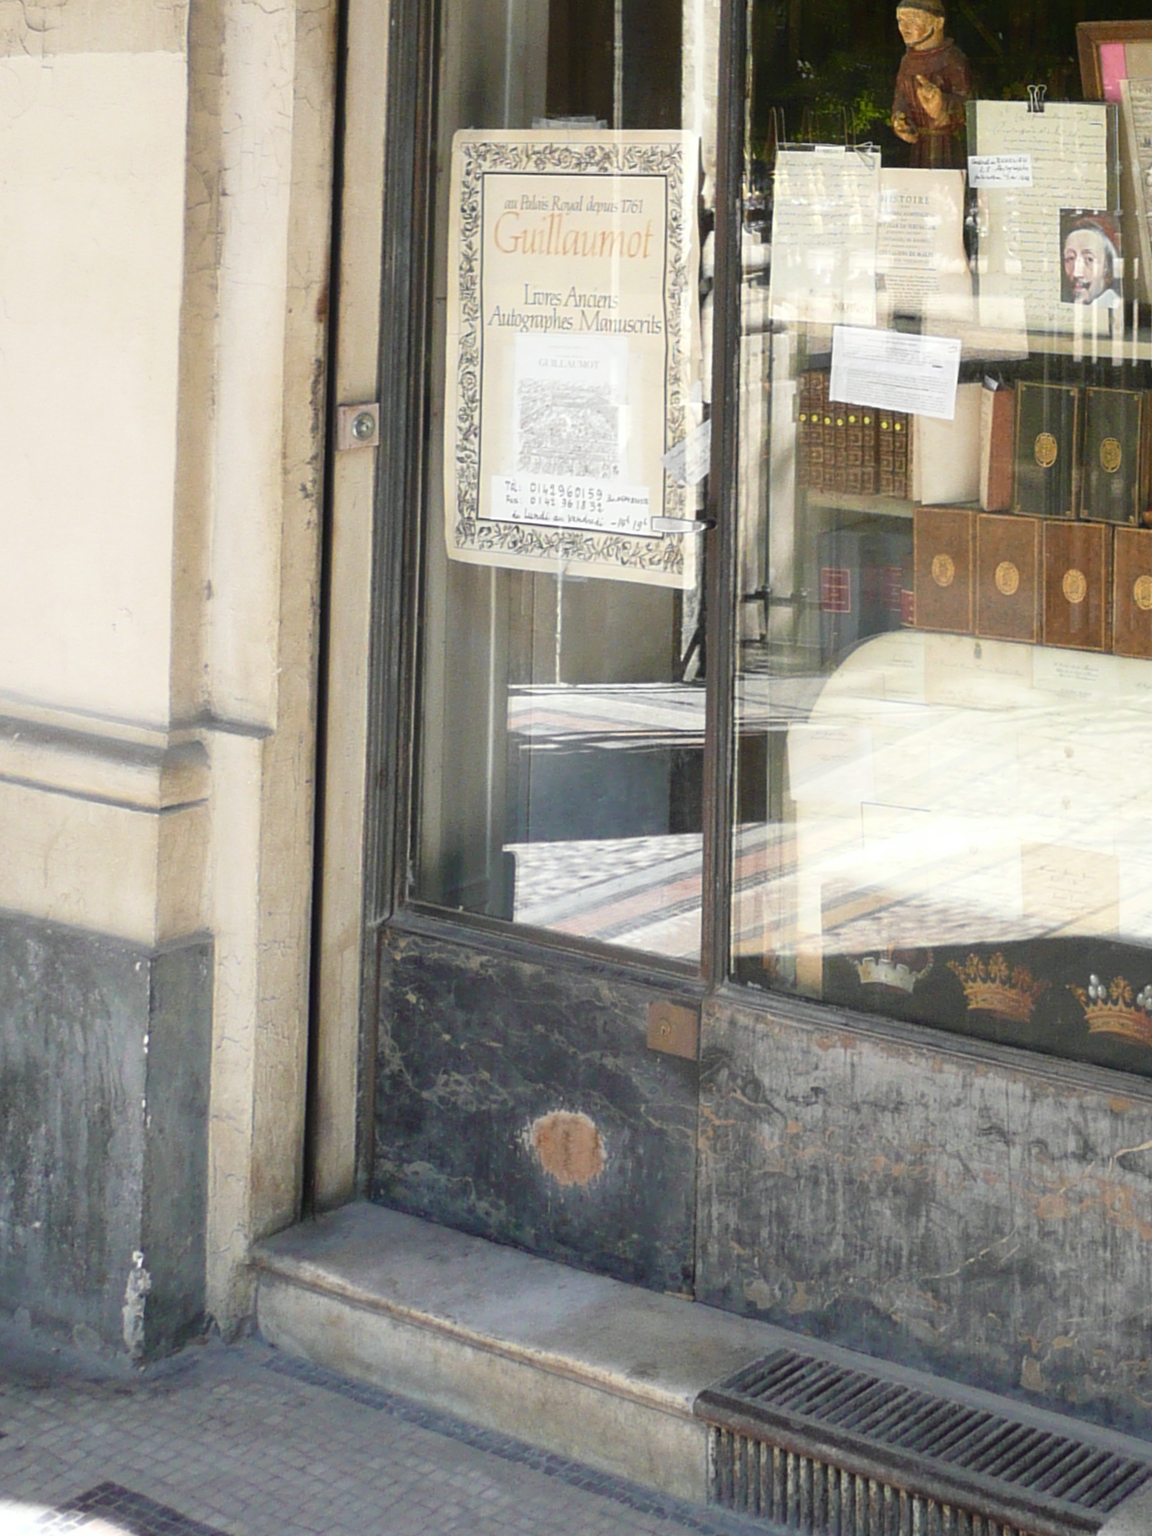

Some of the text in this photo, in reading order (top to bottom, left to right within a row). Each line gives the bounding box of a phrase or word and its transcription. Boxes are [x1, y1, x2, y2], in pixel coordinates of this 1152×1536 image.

[504, 194, 643, 215] au Palais Royal depuis 1761
[494, 211, 654, 259] Guillaumot
[524, 283, 619, 309] Livres Anciens
[487, 305, 662, 334] Autographes Manuscrits
